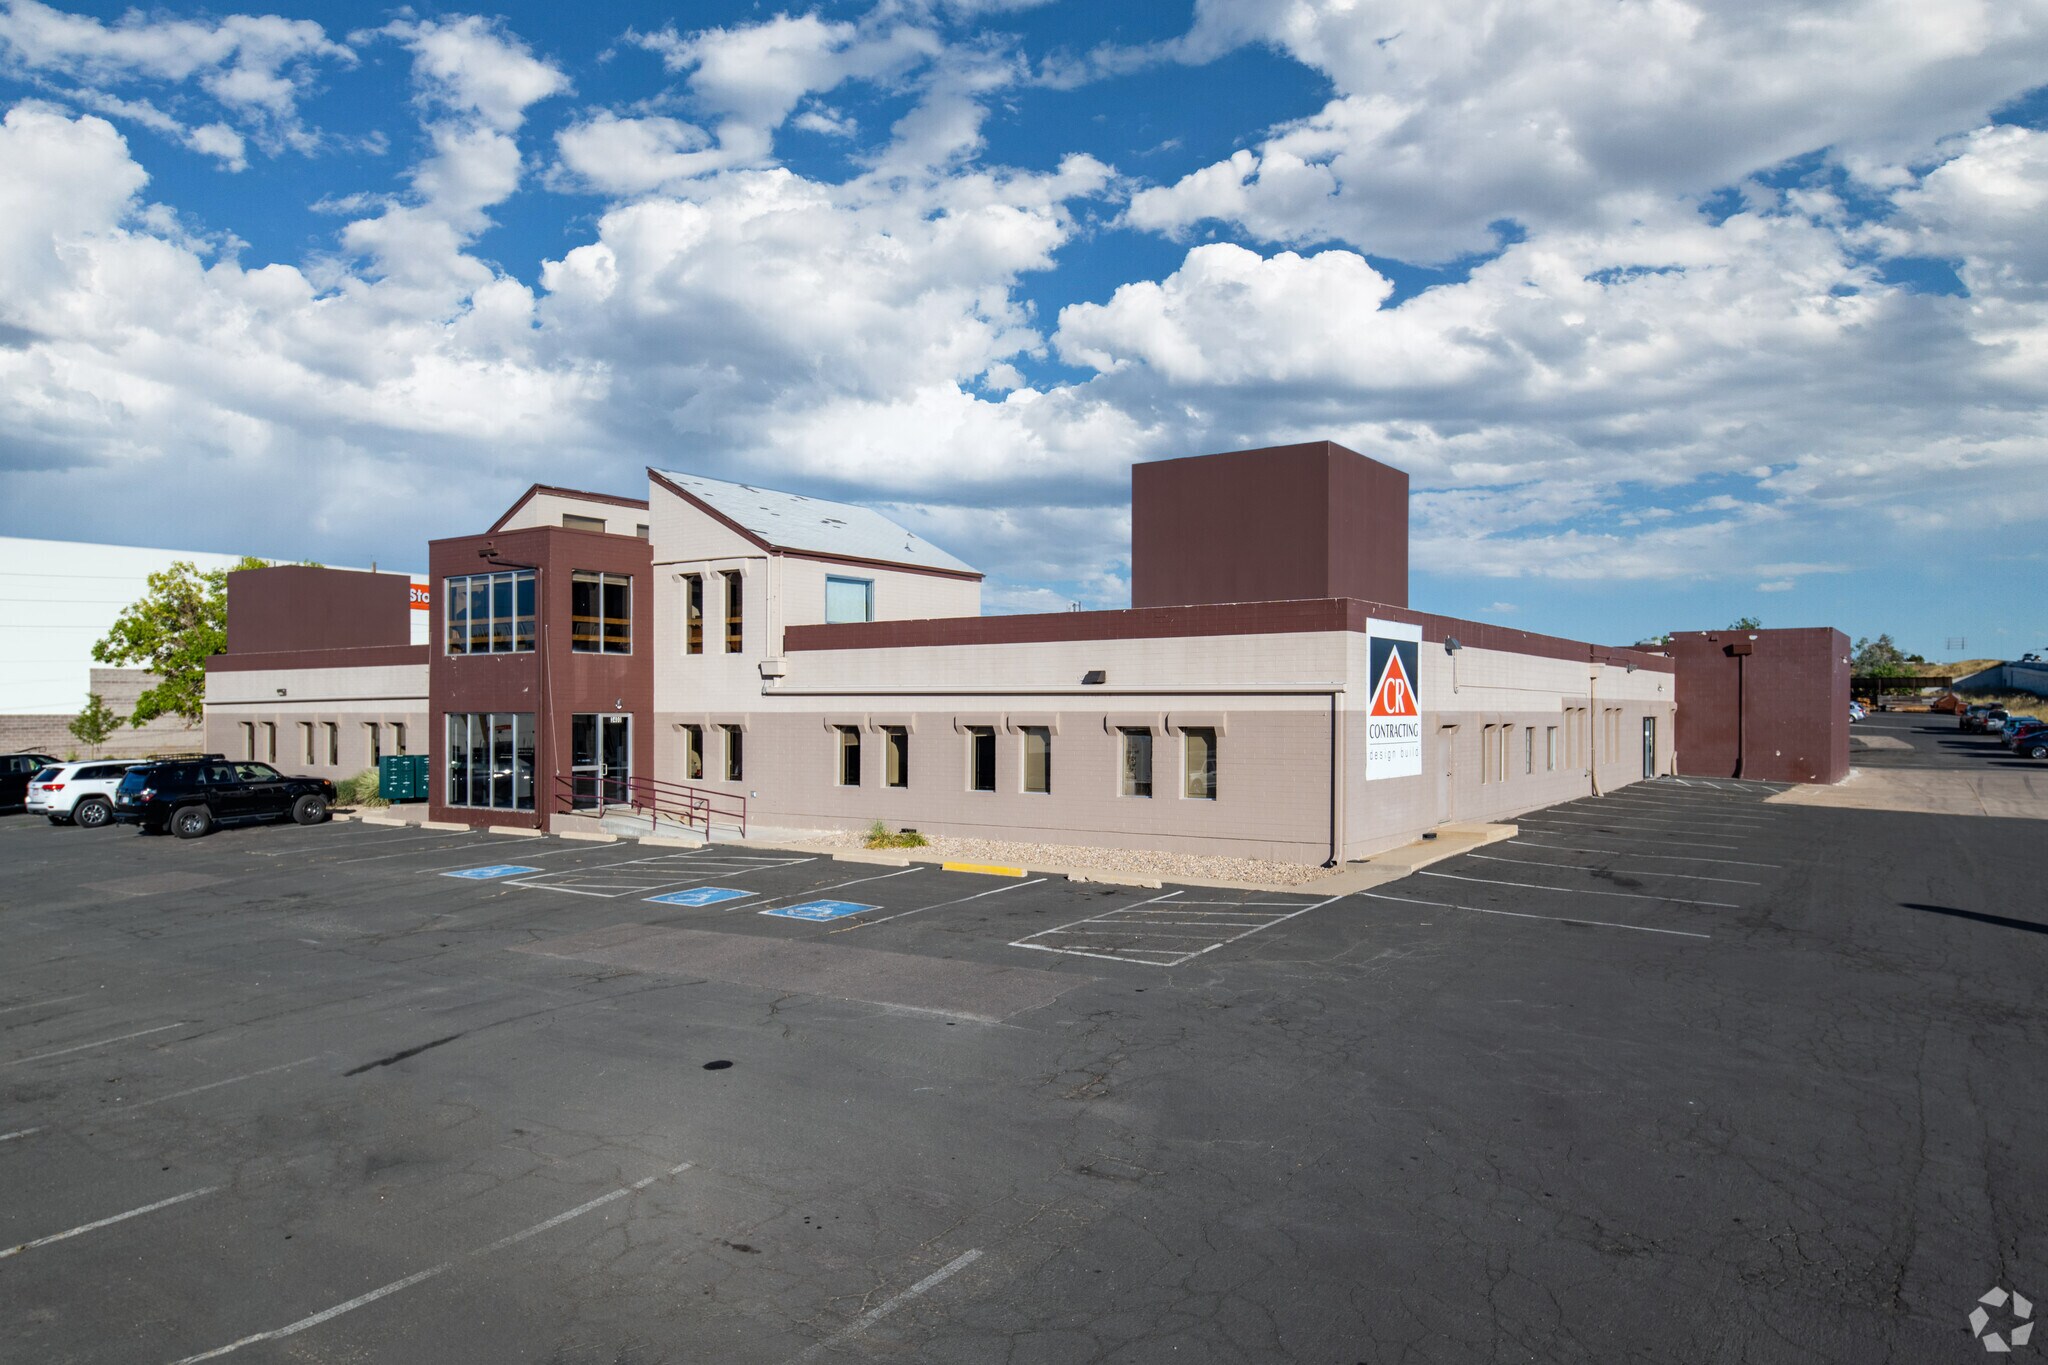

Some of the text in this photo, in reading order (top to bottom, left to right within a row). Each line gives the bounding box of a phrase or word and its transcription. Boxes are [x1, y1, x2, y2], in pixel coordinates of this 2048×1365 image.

[1383, 677, 1405, 714] CR
[1369, 723, 1419, 739] CONTRACTING
[1370, 747, 1419, 762] design build
